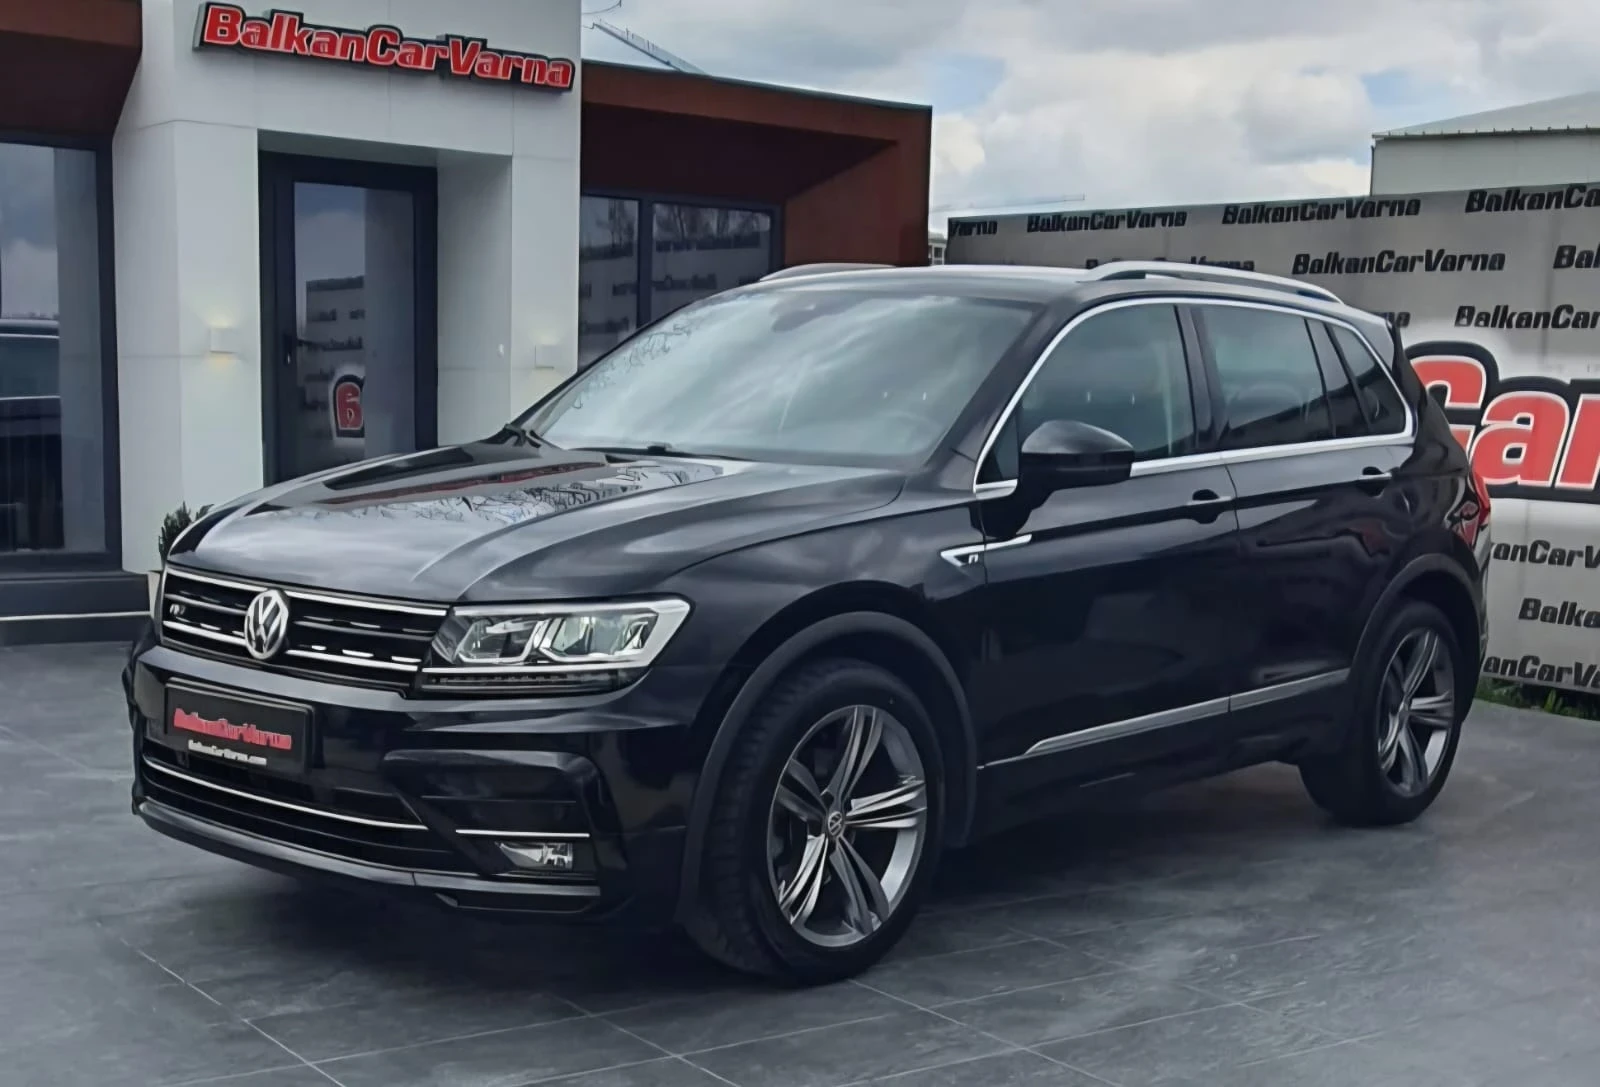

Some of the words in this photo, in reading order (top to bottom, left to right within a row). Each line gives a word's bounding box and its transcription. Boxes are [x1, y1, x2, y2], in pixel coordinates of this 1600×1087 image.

[203, 3, 573, 88] BalkanCarVarna
[1026, 210, 1188, 233] BalkanCarVarna
[1222, 199, 1421, 225] BalkanCarVarna
[1291, 248, 1506, 275] BalkanCarVarna
